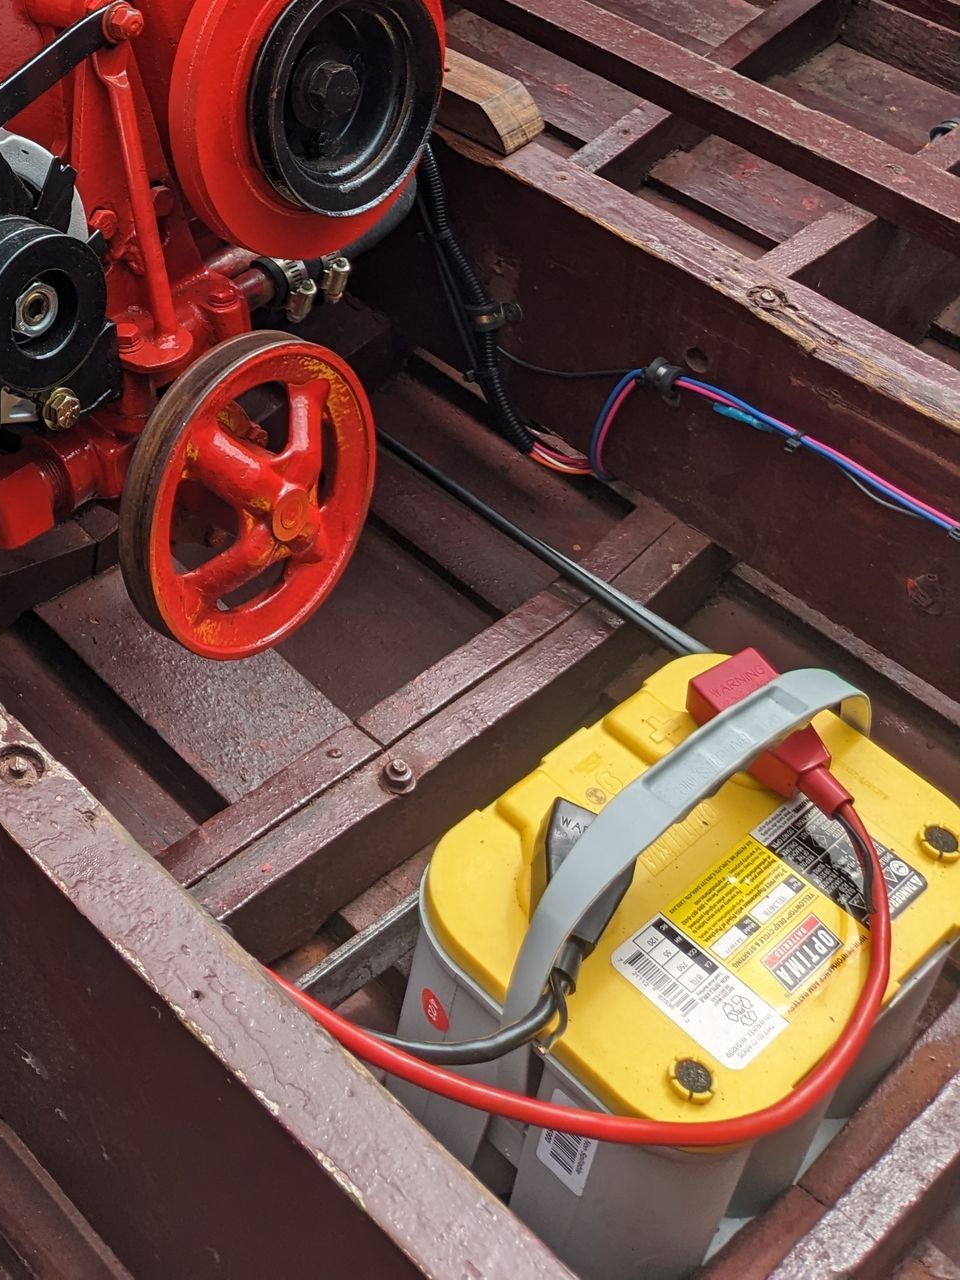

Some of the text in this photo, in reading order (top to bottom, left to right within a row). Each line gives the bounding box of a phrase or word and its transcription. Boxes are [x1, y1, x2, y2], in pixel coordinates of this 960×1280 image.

[708, 664, 766, 698] WARNING
[724, 913, 737, 925] Proof
[771, 916, 787, 931] DEEP
[645, 934, 659, 946] 120
[661, 935, 683, 958] AH 55
[757, 928, 775, 944] CYCLE
[772, 926, 807, 958] BATTERIES
[675, 947, 698, 972] CCA 750
[731, 945, 757, 969] STARTING
[774, 927, 838, 986] OPTIMA
